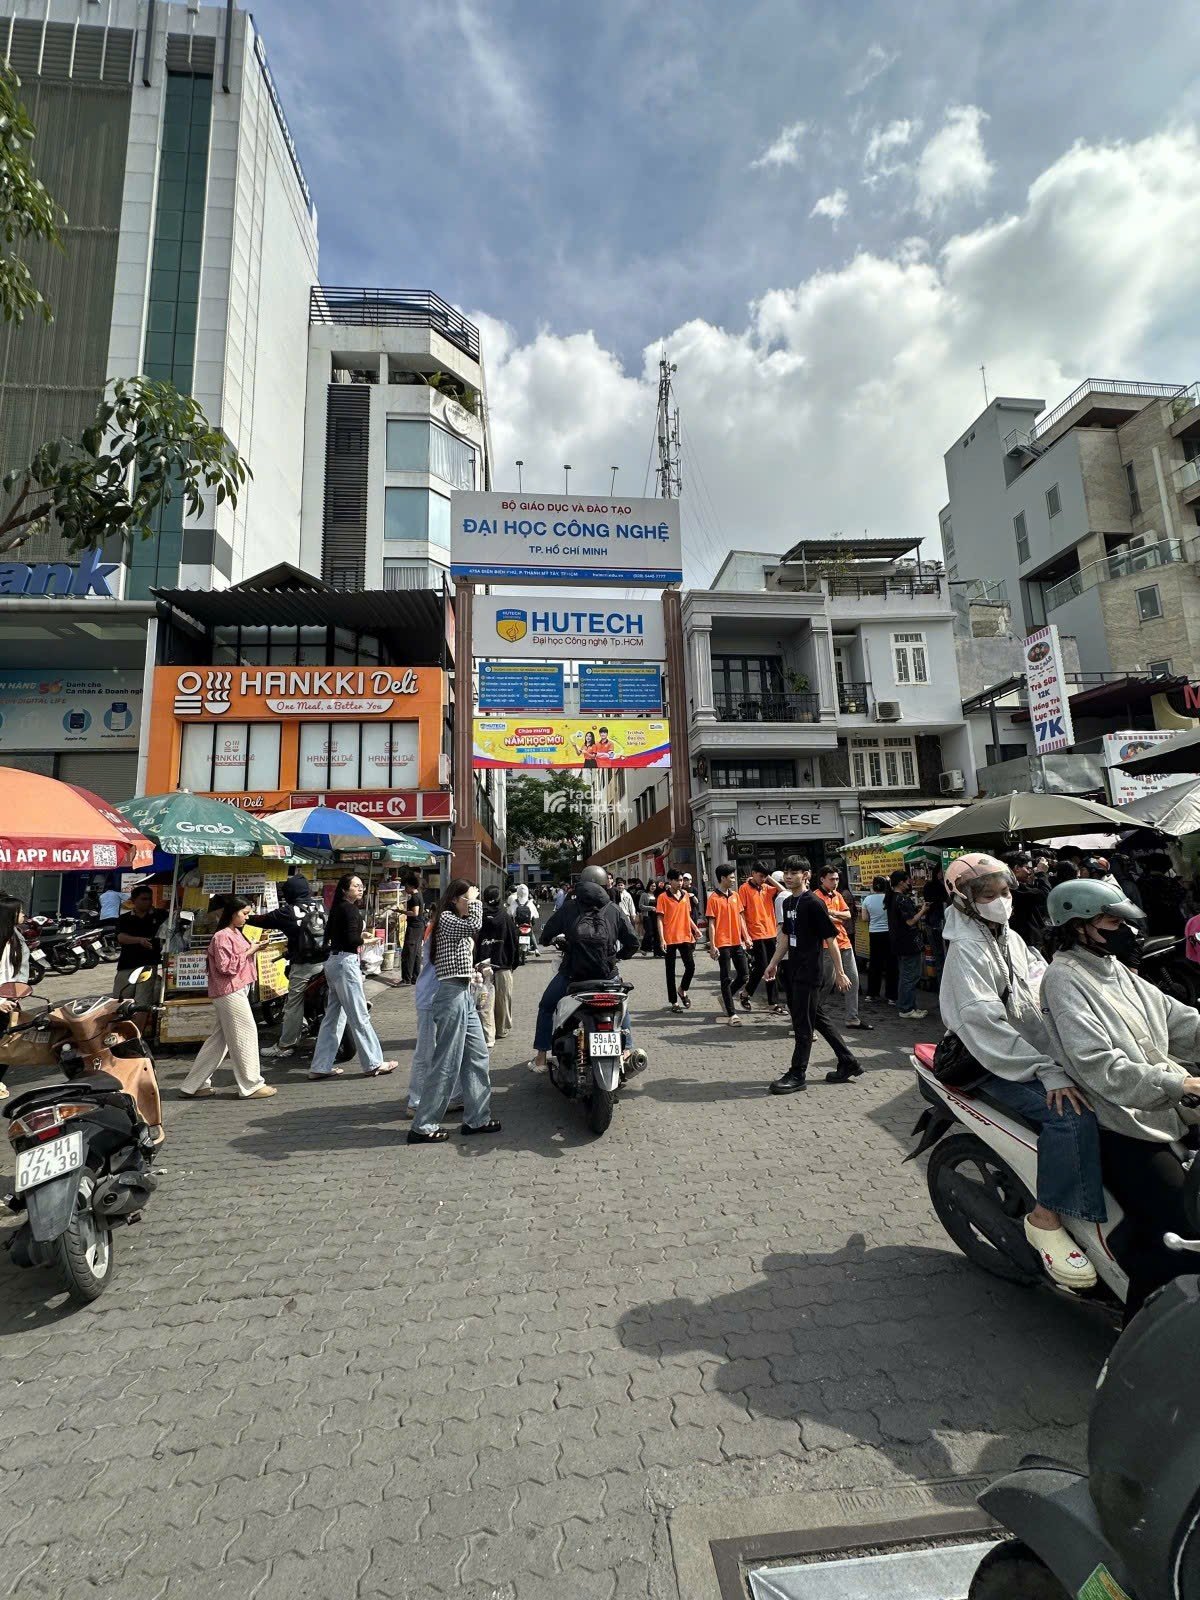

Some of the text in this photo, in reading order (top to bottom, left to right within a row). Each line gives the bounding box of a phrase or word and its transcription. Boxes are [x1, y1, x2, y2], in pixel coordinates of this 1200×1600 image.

[502, 500, 631, 515] BỘ GIÁO DỤC VÀ ĐÀO TẠO
[463, 518, 669, 542] ĐẠI HỌC CÔNG NGHỆ
[529, 543, 608, 556] TP. HỒ CHÍ MINH
[532, 611, 643, 634] HUTECH
[533, 636, 546, 646] Đại
[547, 636, 564, 647] học
[565, 636, 587, 647] Công
[588, 637, 608, 648] nghệ
[241, 668, 419, 695] HANKKI Deli
[1030, 681, 1042, 692] Trà
[1043, 676, 1057, 688] Sữa
[1038, 688, 1050, 699] 12K
[277, 701, 295, 710] One
[334, 702, 363, 710] Better
[367, 702, 383, 710] You
[1035, 716, 1065, 741] 7K
[505, 734, 565, 746] NĂM HỌC MỚI
[243, 796, 263, 808] Deli
[336, 798, 405, 815] CIRCLE K
[756, 814, 821, 826] CHEESE
[176, 821, 235, 835] Grab
[16, 849, 47, 862] APP
[53, 849, 90, 863] NGAY
[947, 1096, 991, 1126] VISION
[28, 1138, 71, 1168] 72-H1
[21, 1151, 77, 1187] 024.38
